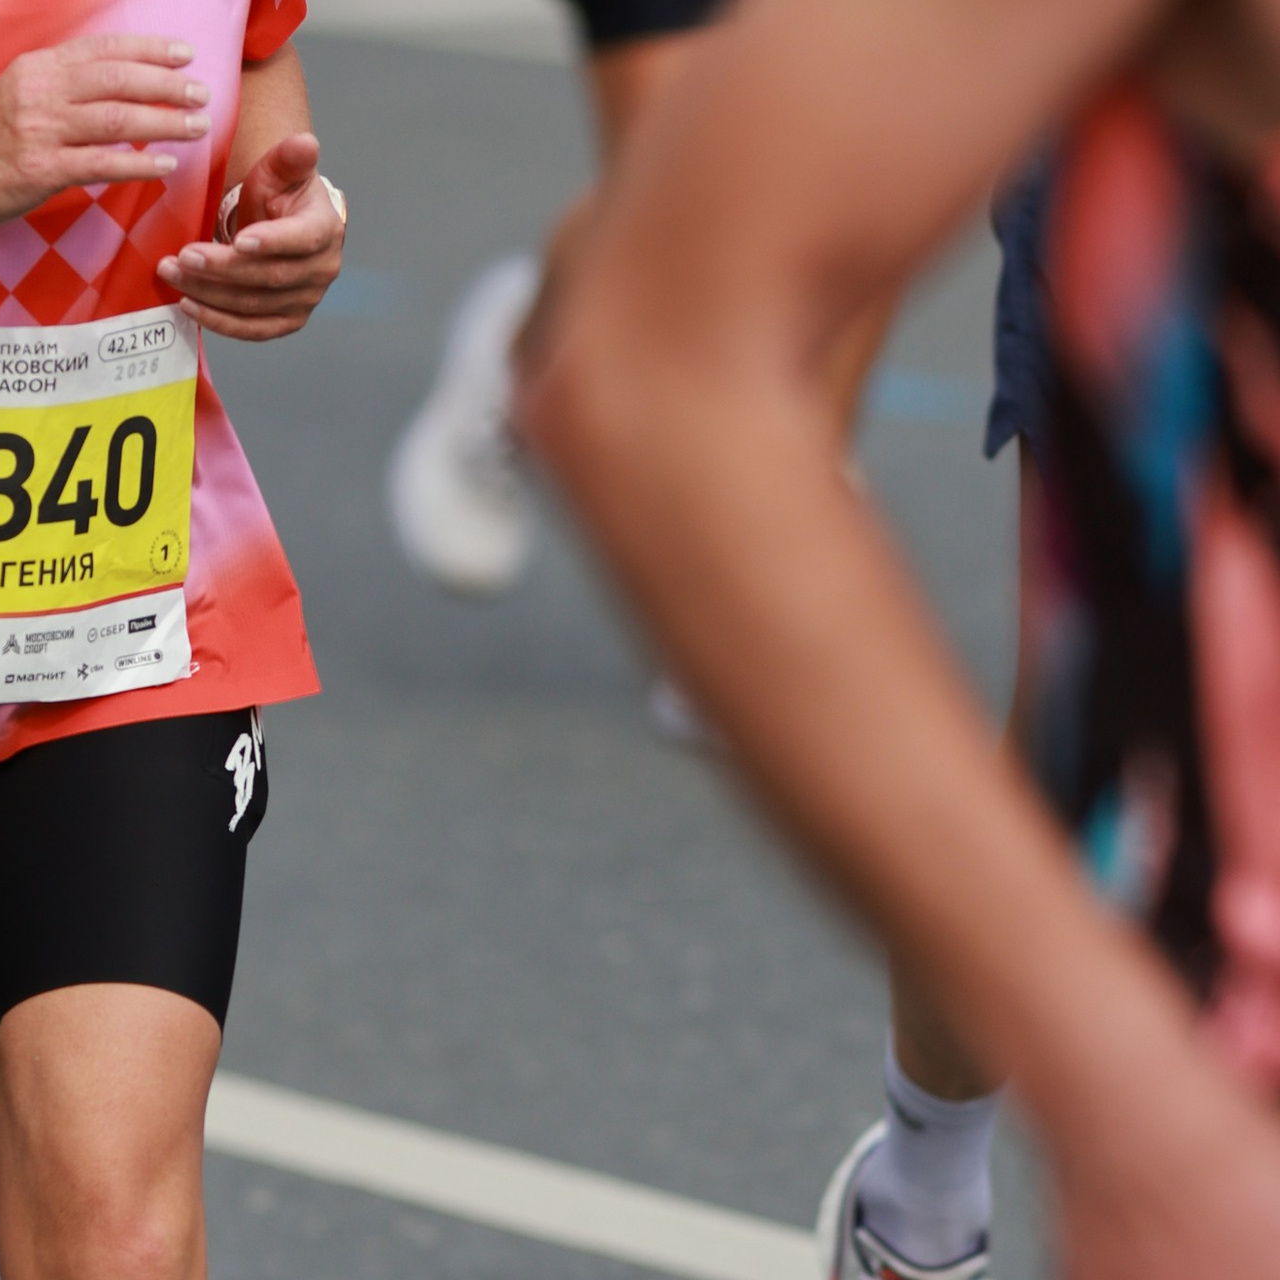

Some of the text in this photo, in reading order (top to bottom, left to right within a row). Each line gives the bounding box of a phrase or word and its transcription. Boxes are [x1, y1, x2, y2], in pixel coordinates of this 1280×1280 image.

[107, 333, 138, 354] 42,2
[160, 543, 169, 561] 1
[25, 627, 75, 643] МОСКОВСКИЙ
[100, 623, 126, 638] СБЕР
[24, 643, 49, 655] СПОРТ
[118, 653, 153, 668] WINLINE
